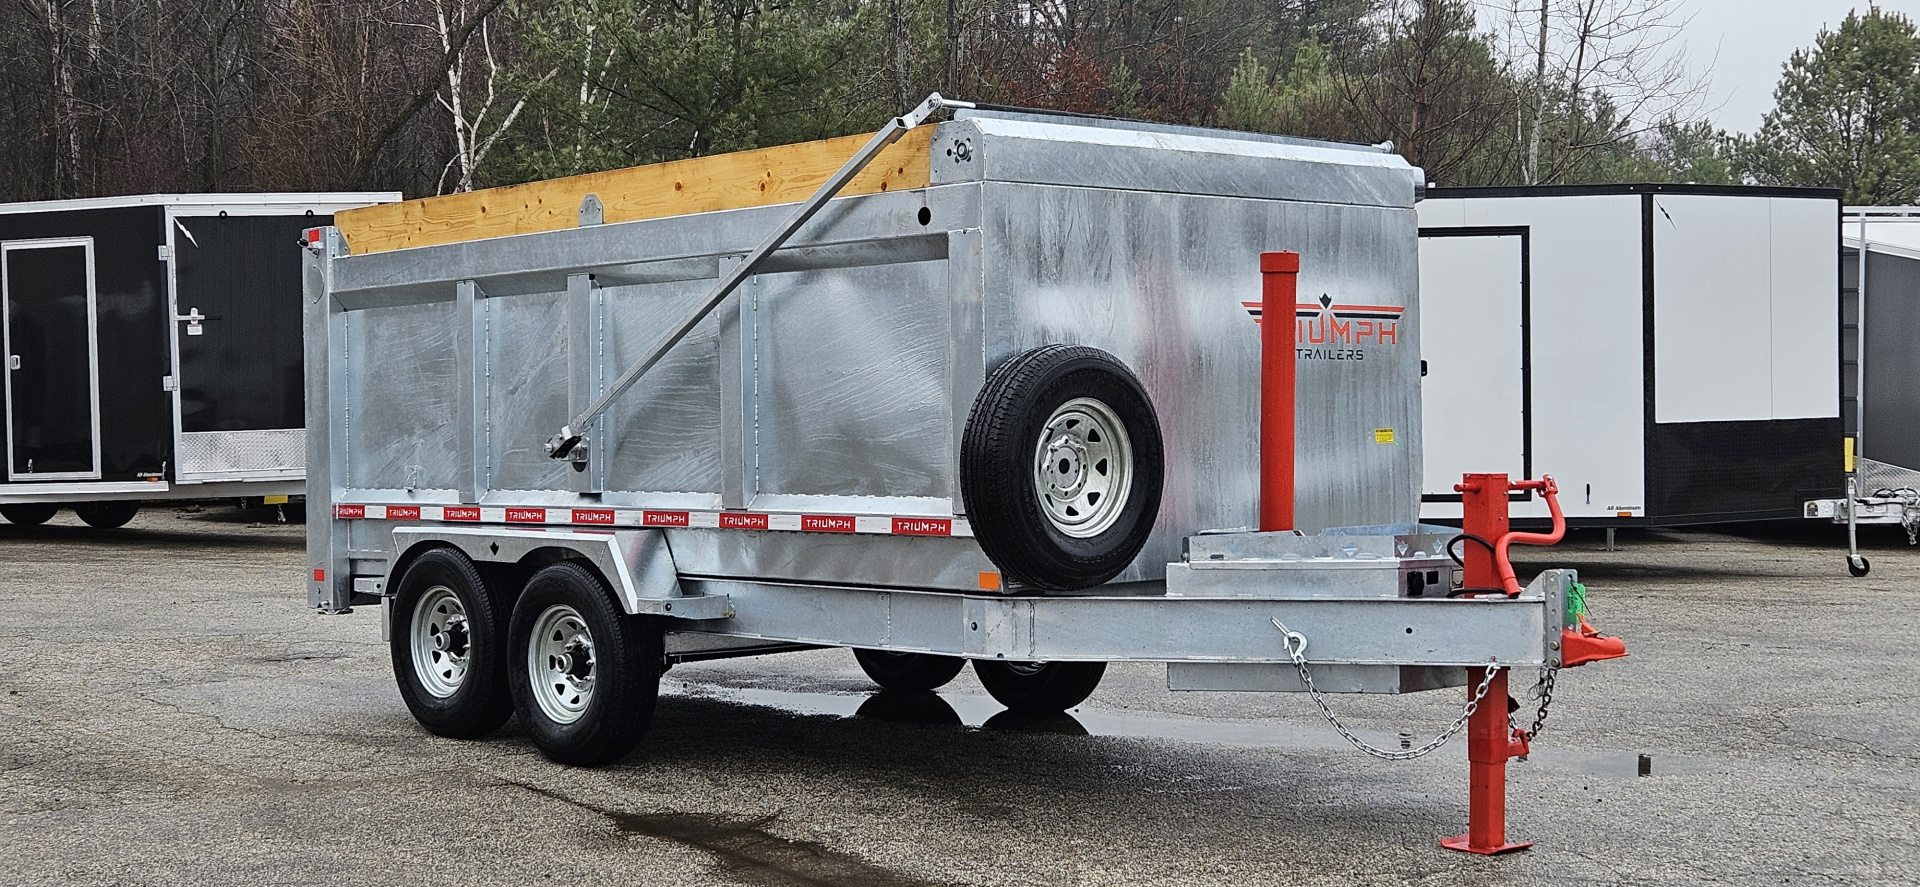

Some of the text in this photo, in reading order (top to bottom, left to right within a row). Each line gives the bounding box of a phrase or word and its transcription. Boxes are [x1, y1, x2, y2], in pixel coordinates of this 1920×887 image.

[1254, 313, 1396, 344] IUMPH
[1296, 348, 1363, 360] TRAILERS
[389, 509, 418, 517] TRIUMPH
[446, 510, 478, 518] TRIUMPH
[509, 511, 542, 520] TRIUMPH
[575, 512, 611, 521] TRIUMPH
[647, 514, 685, 523] TRIUMPH
[723, 516, 764, 526] TRIUMPH
[806, 519, 850, 529] TRIUMPH
[897, 521, 946, 532] TRIUMPH
